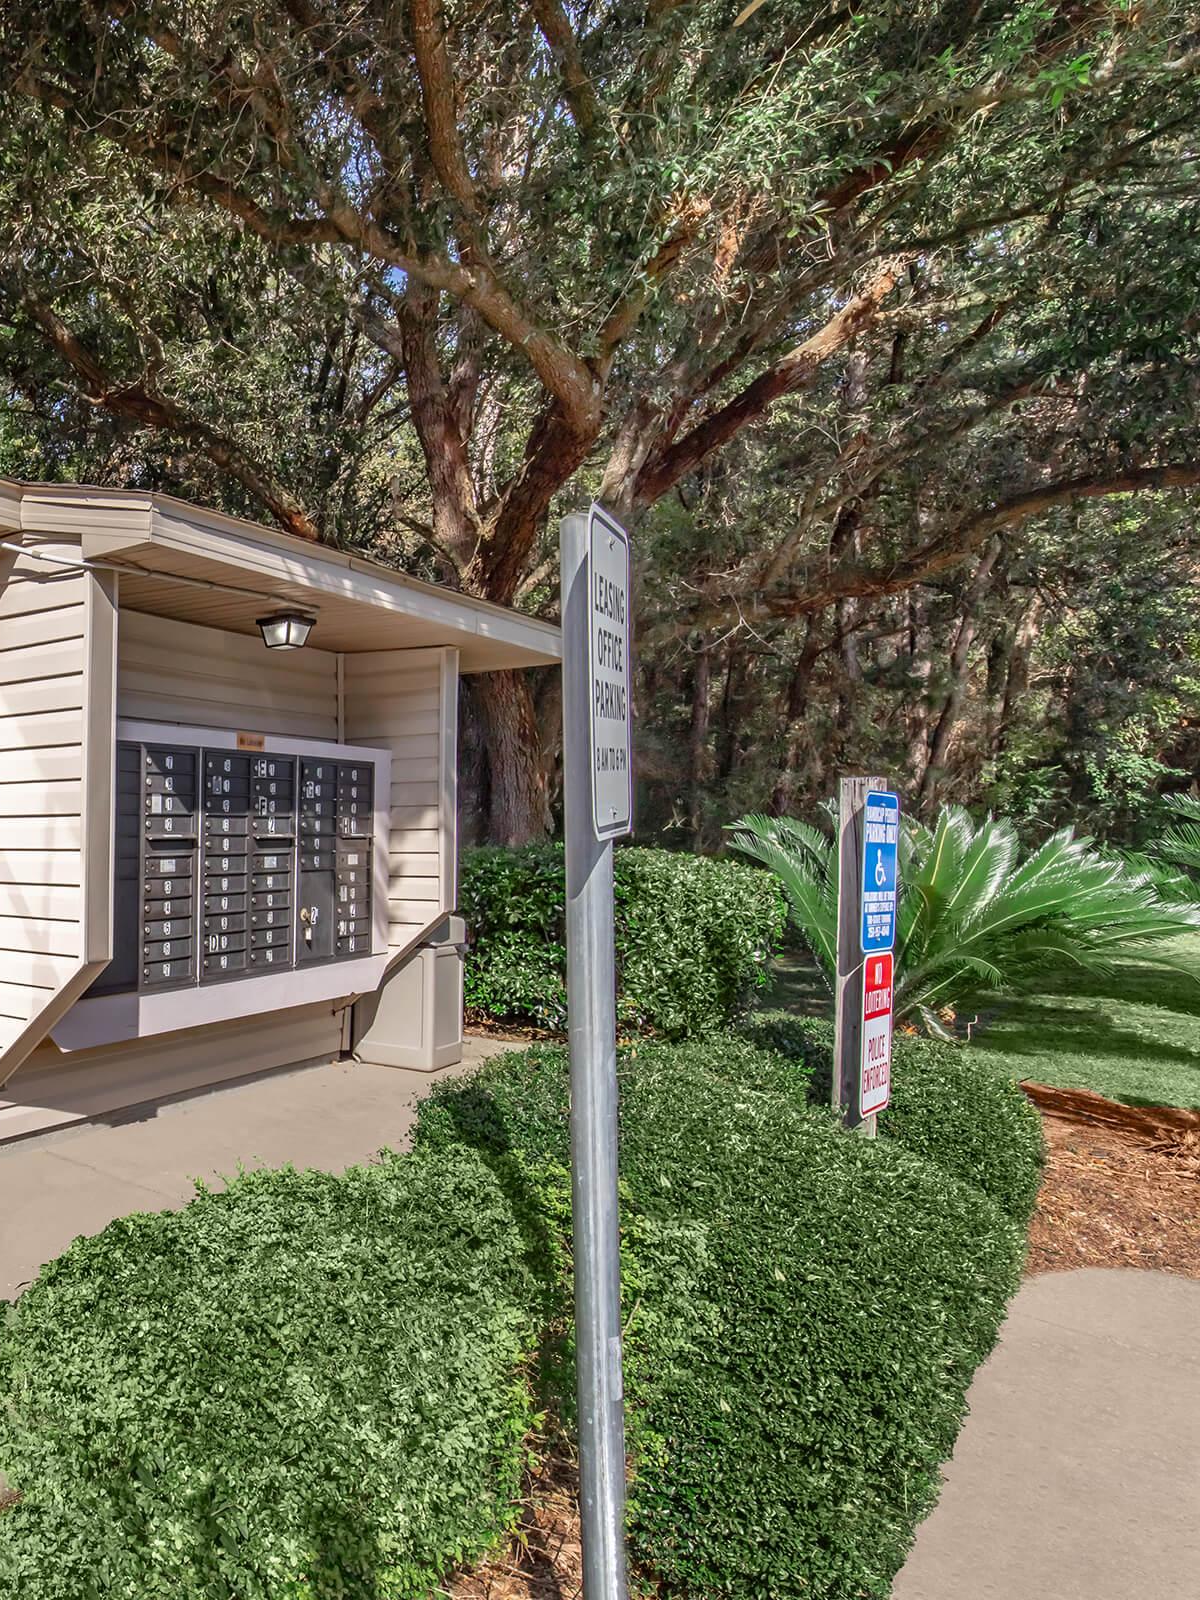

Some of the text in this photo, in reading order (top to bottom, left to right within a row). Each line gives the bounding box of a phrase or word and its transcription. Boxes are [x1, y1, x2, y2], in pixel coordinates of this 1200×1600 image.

[594, 571, 625, 625] LEASING
[597, 627, 623, 673] OFFICE
[595, 678, 626, 721] PARKING
[602, 748, 609, 772] AM
[609, 748, 616, 772] TO
[875, 962, 883, 985] NO
[865, 987, 891, 1014] LOITERING
[869, 1035, 886, 1063] POLICE
[864, 1063, 888, 1093] ENFORCED
